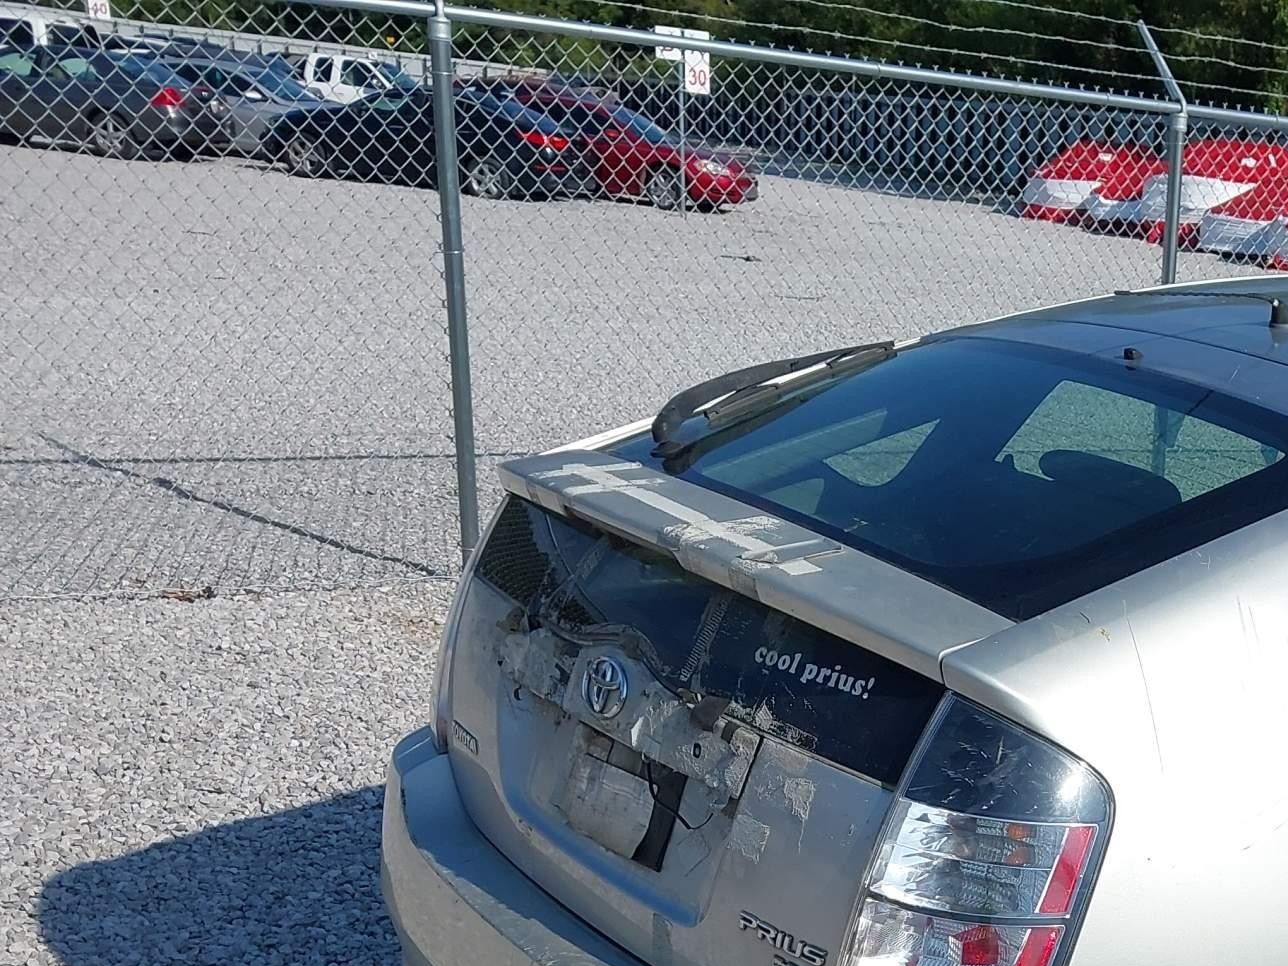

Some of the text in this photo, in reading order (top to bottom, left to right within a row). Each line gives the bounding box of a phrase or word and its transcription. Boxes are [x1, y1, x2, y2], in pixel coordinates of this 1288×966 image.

[688, 67, 707, 87] 30
[754, 646, 876, 700] cool prius!
[739, 911, 827, 966] PRIUS
